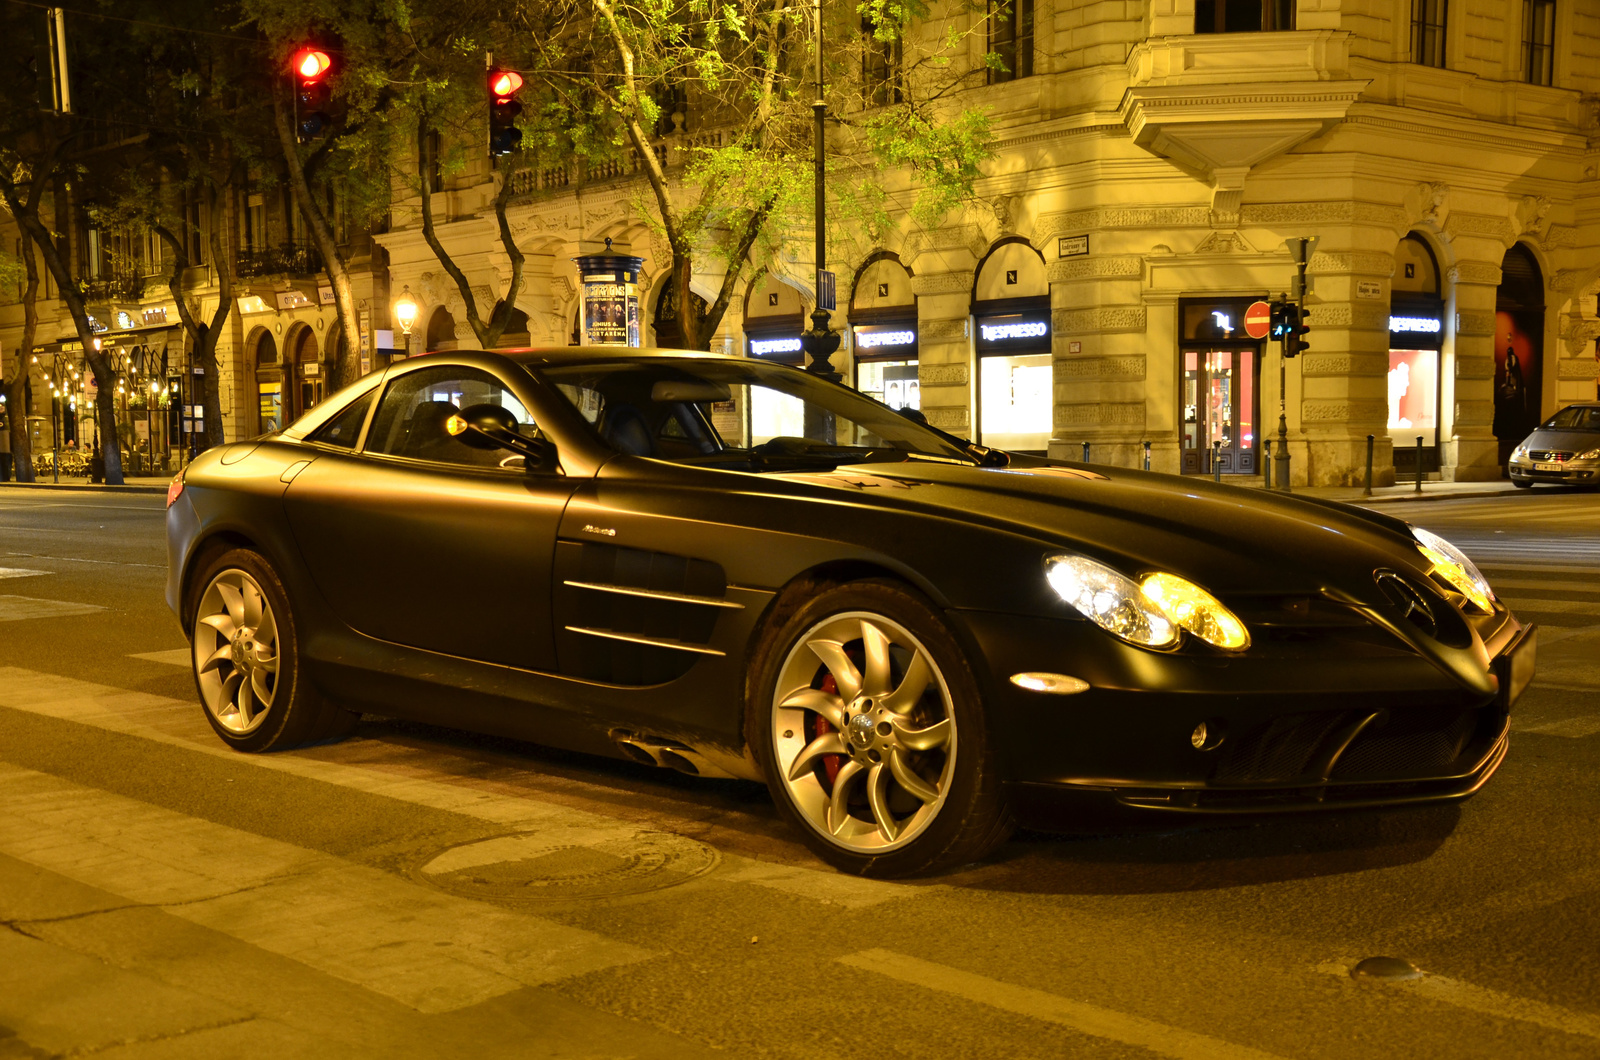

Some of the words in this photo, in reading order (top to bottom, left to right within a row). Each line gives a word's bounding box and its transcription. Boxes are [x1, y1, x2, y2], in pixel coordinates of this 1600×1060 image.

[585, 284, 625, 297] SCORPIONS
[981, 322, 1046, 341] NESPRESSO
[1389, 316, 1440, 332] NESPRESSO
[751, 339, 802, 355] NESPRESSO
[857, 331, 914, 348] NESPRESSO
